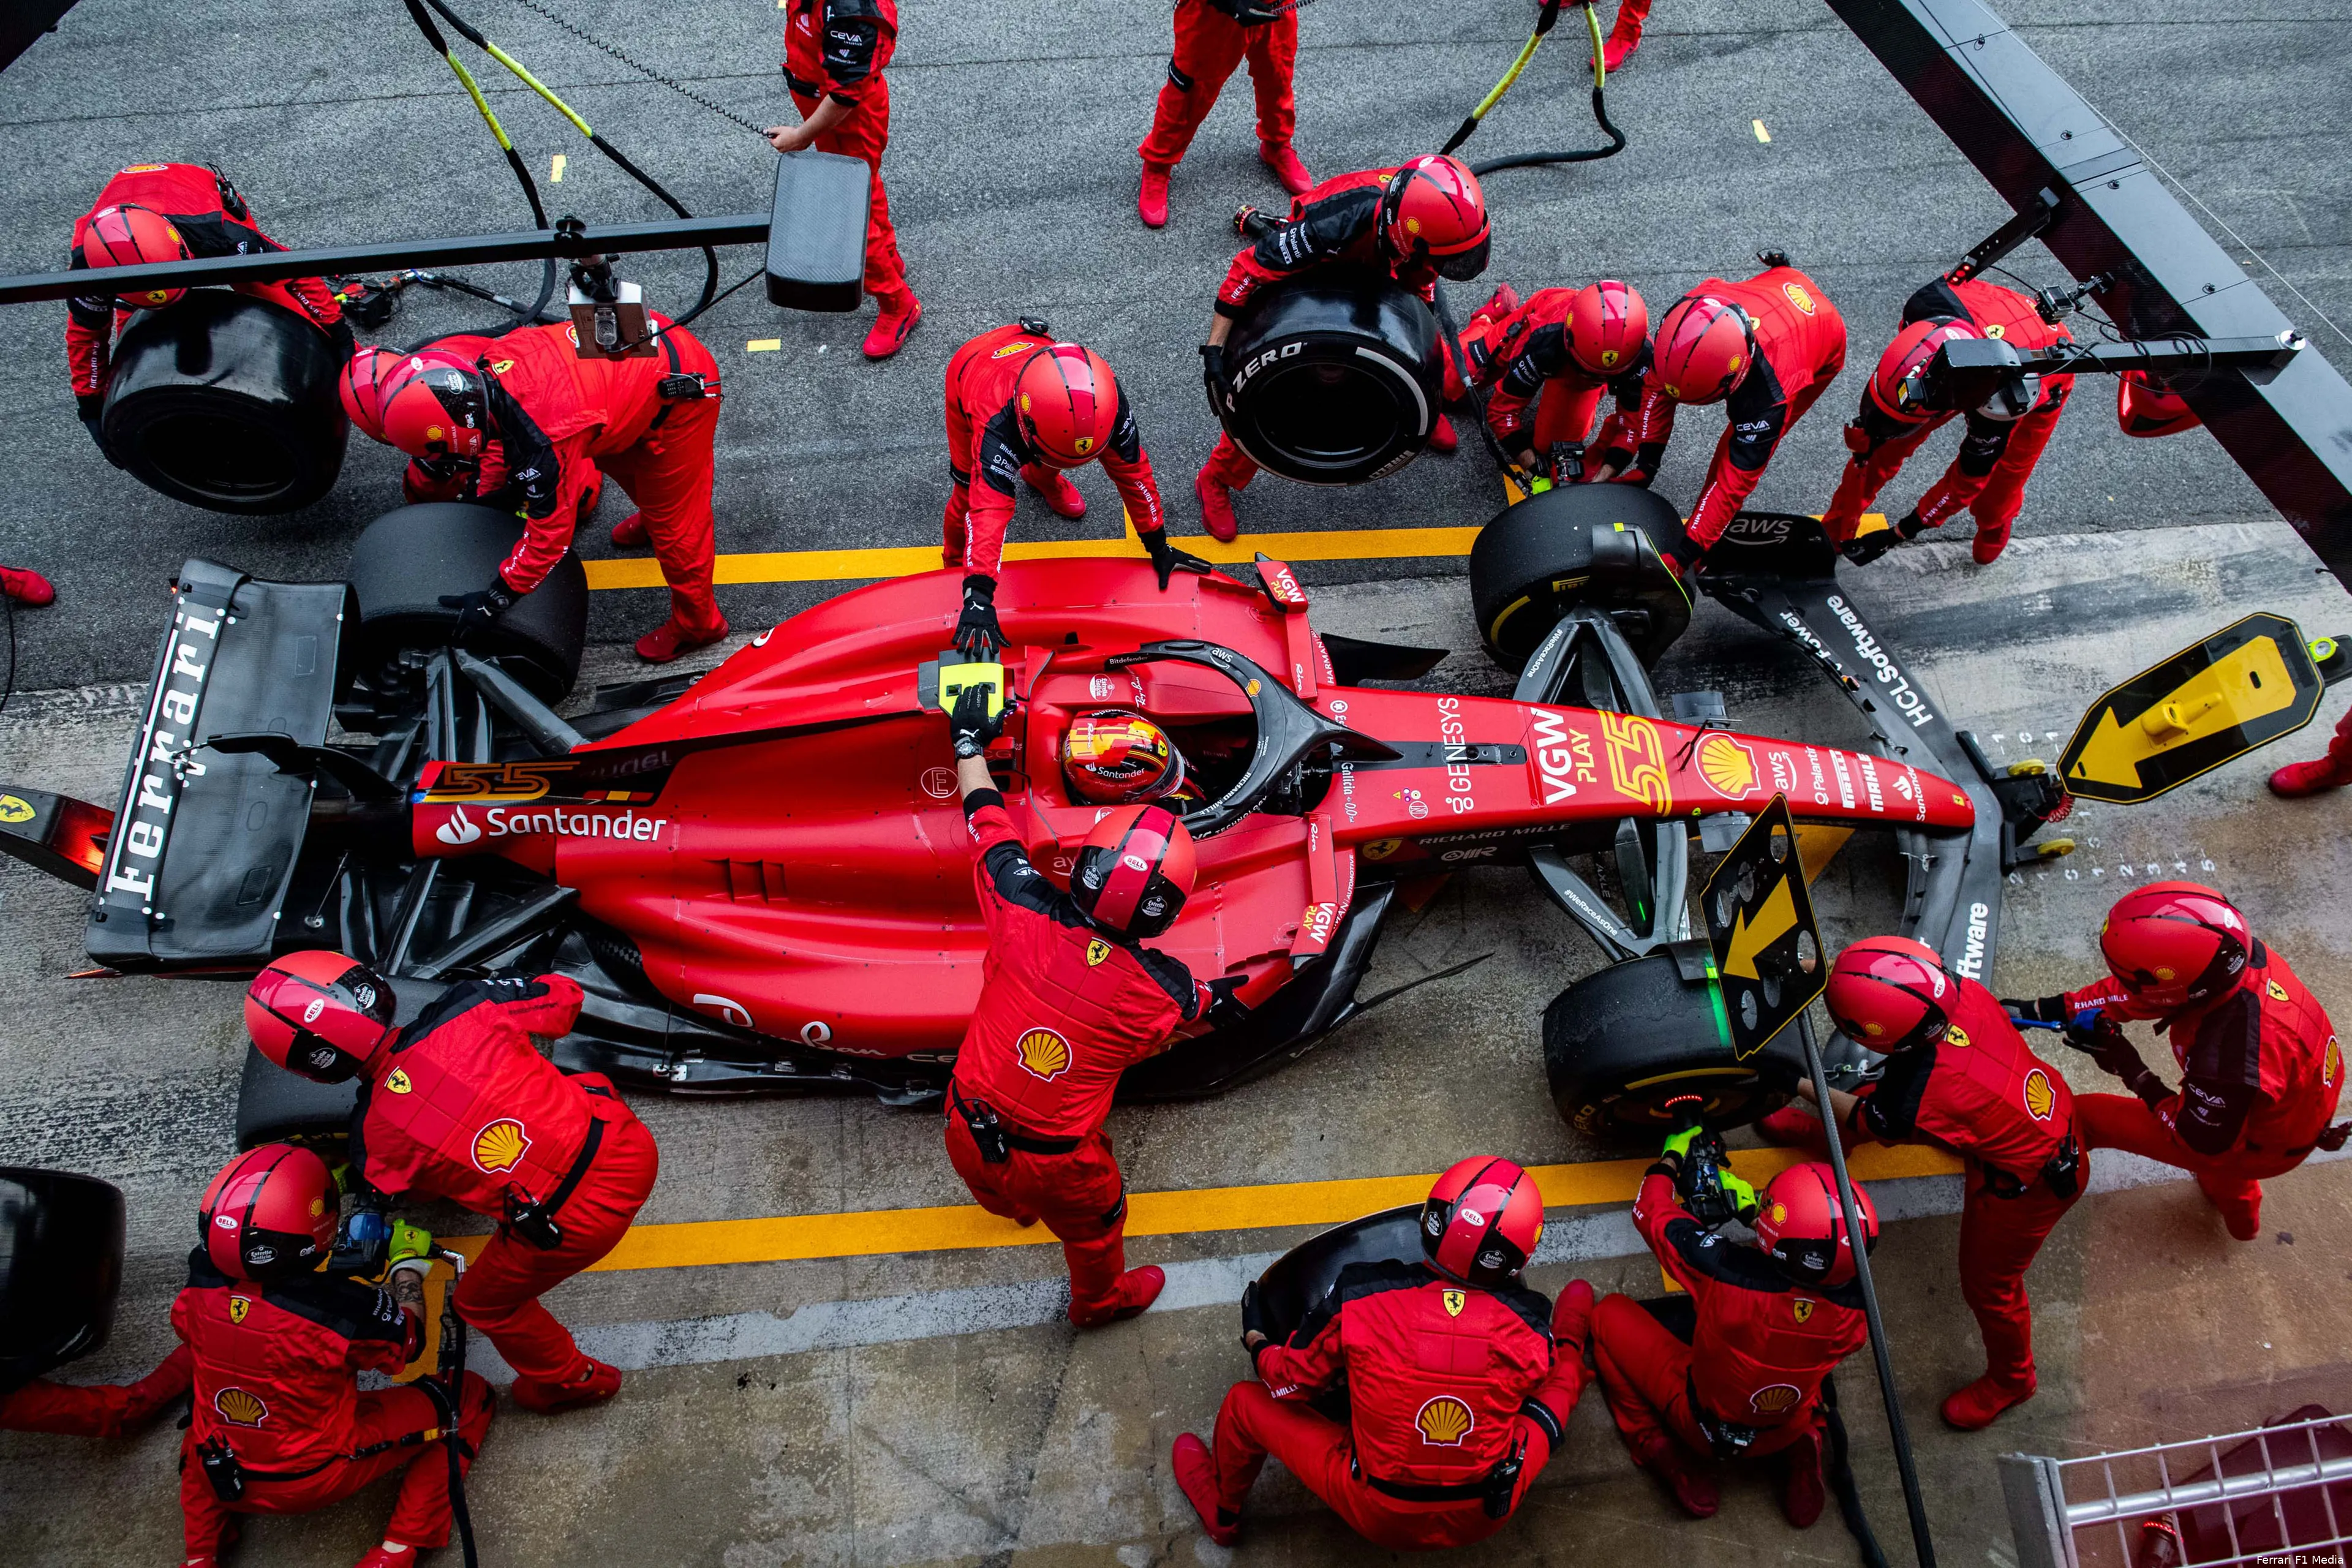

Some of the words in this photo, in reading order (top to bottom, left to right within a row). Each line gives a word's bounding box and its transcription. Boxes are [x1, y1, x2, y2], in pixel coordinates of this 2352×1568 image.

[795, 19, 813, 38] antander
[830, 31, 862, 43] CEVA
[1232, 341, 1303, 394] ZERO
[1736, 420, 1770, 431] CEVA
[1729, 518, 1794, 534] aws
[1270, 580, 1288, 600] PLAY
[1276, 567, 1305, 603] VGW
[1211, 647, 1233, 663] aws
[1318, 639, 1335, 685] HARMAN
[1526, 628, 1564, 678] #WeRaceAsOne
[105, 612, 222, 902] Ferrari
[1437, 697, 1472, 791] GENESYS
[1531, 706, 1577, 805] VGW
[1568, 728, 1597, 783] PLAY
[1096, 766, 1145, 779] Santander
[1341, 761, 1355, 796] Galicia
[1597, 709, 1672, 817] 55
[1768, 751, 1789, 791] aws
[1805, 745, 1826, 790] Palantir
[1828, 748, 1856, 809] PIRELLI
[424, 760, 581, 802] 55
[1222, 771, 1252, 802] RICHARD
[1855, 752, 1884, 812] MAHLE
[486, 807, 666, 842] Santander
[1200, 798, 1224, 816] MILLE
[1419, 830, 1506, 846] RICHARD
[1512, 823, 1572, 835] MILLE
[1127, 857, 1144, 869] BELL
[1346, 853, 1355, 898] AUTOMOTIVE
[1301, 904, 1317, 930] PLAY
[1311, 902, 1338, 944] VGW
[1563, 888, 1618, 937] #WeRaceAsOne
[306, 1003, 322, 1020] BELL
[2188, 1082, 2226, 1104] CEVA
[217, 1218, 234, 1227] BELL
[1464, 1212, 1483, 1225] BELL
